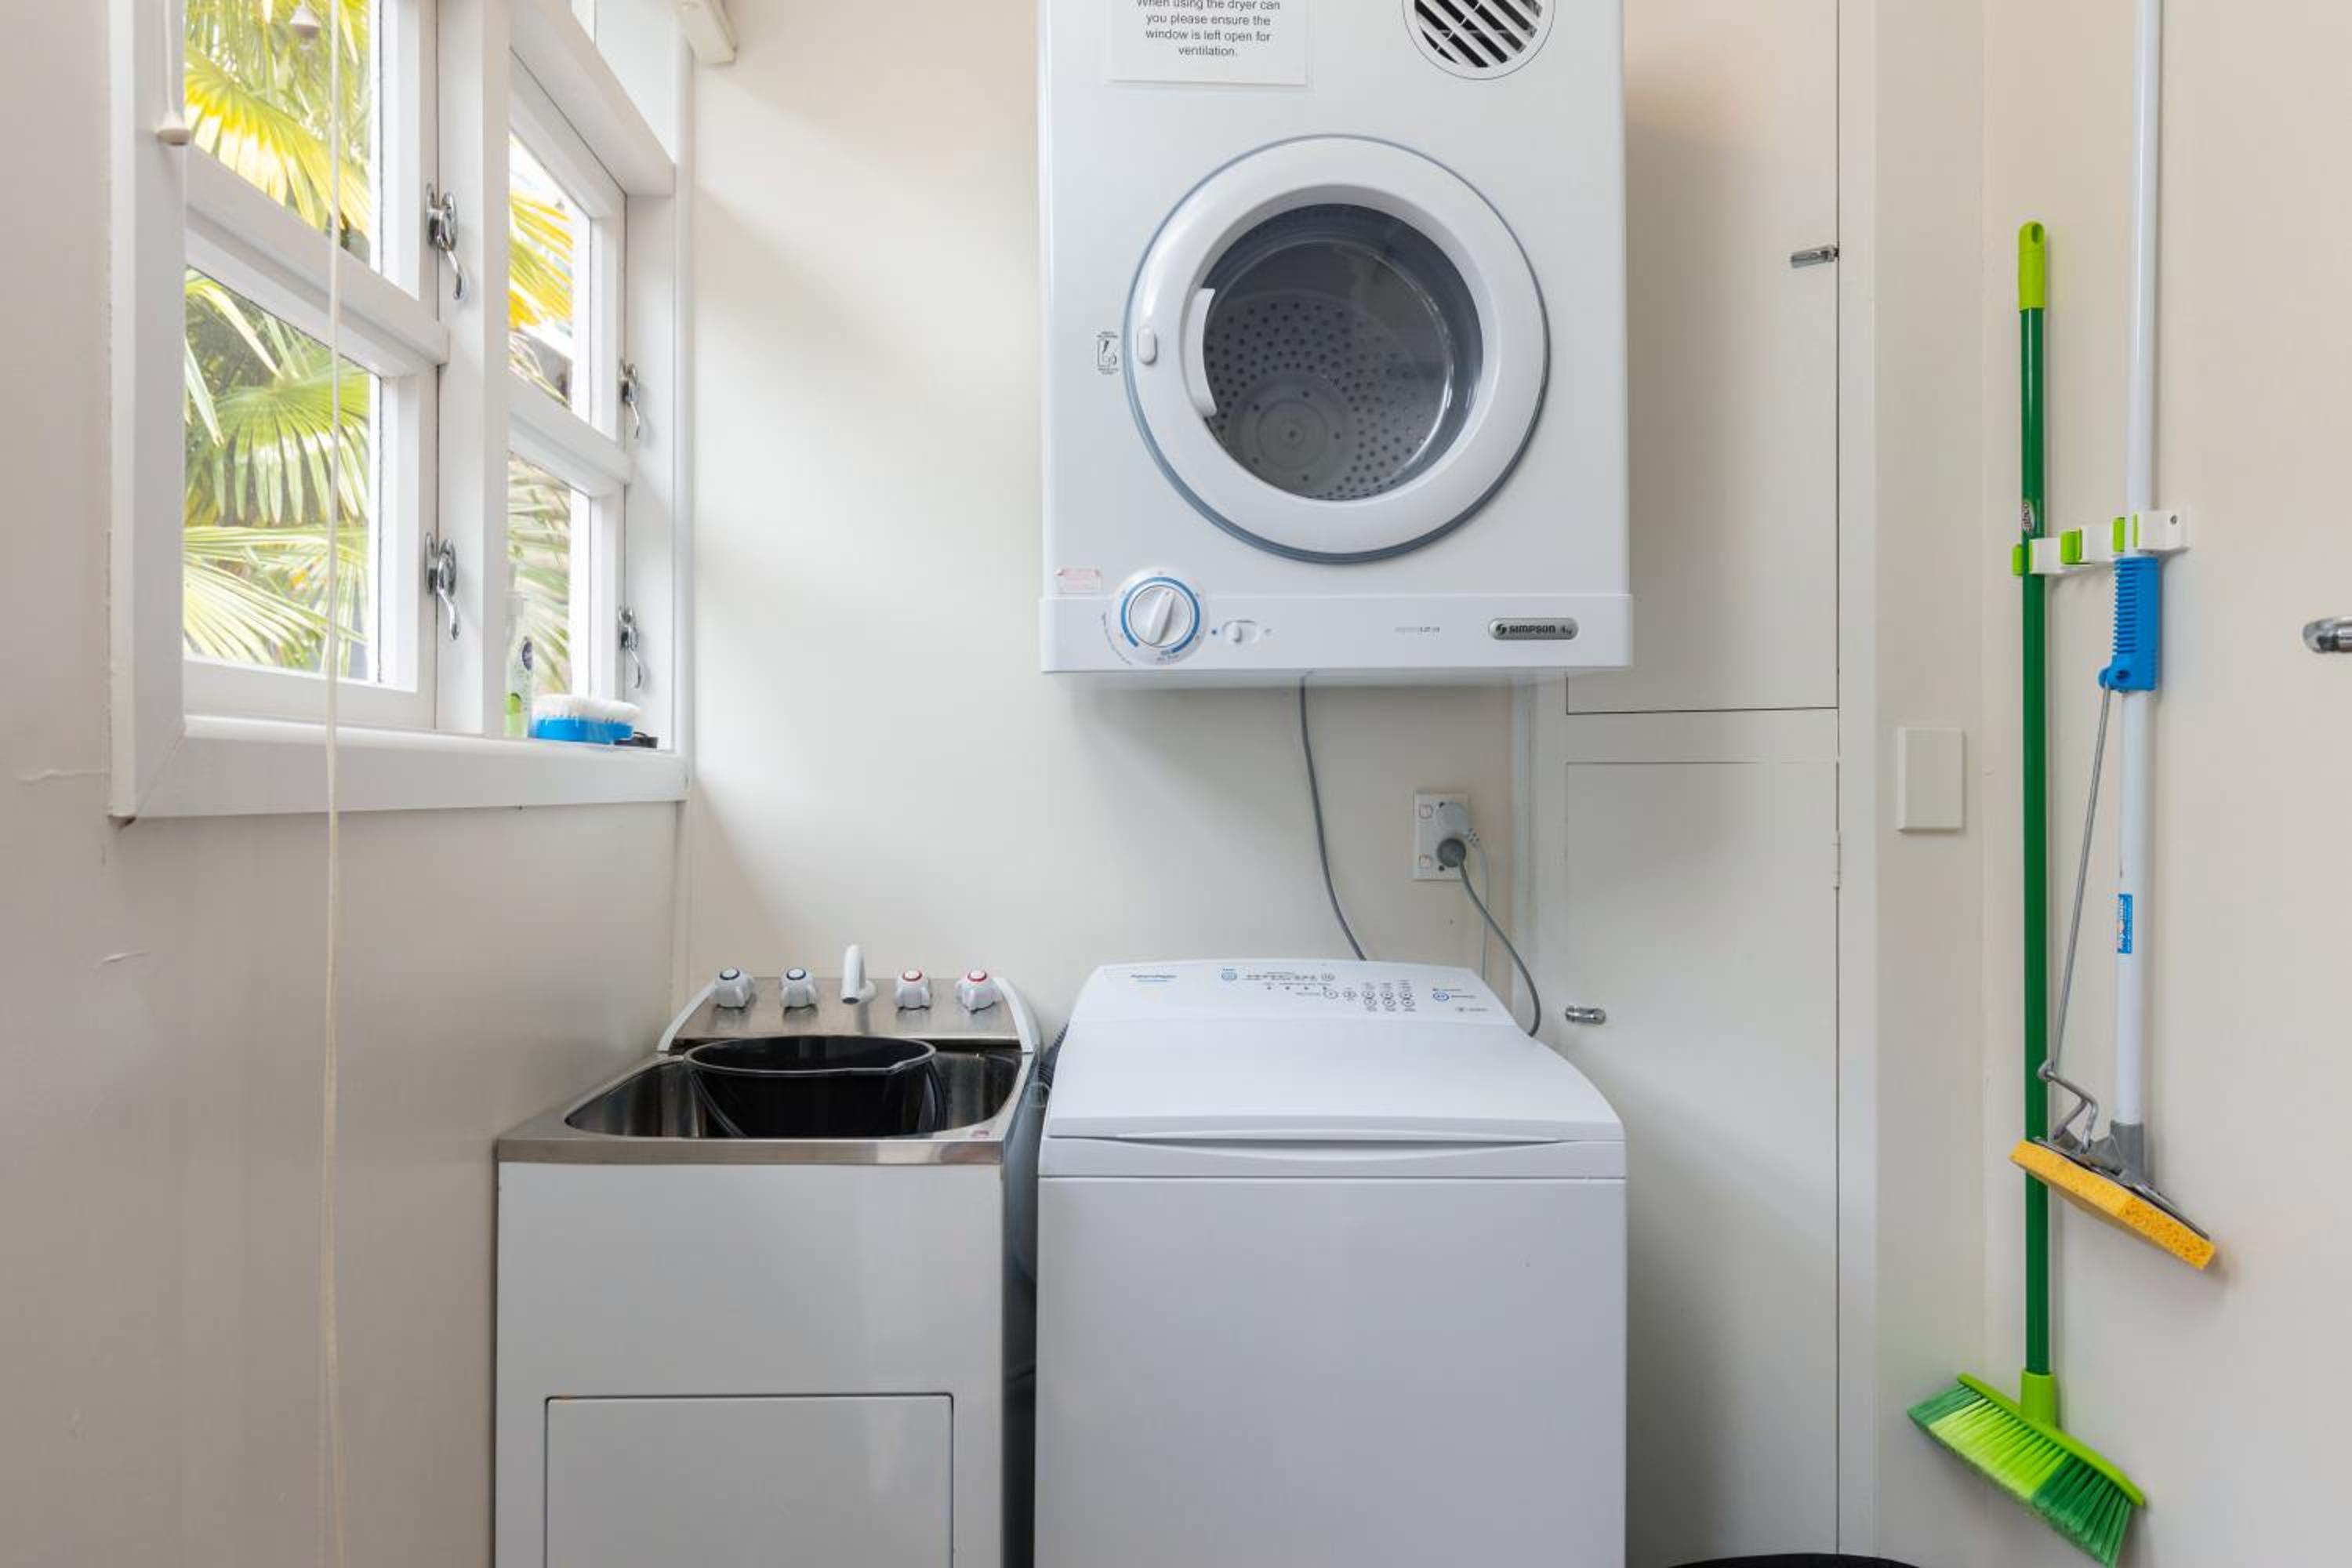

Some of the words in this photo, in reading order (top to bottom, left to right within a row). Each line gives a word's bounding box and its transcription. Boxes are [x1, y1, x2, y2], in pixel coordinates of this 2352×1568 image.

[1174, 0, 1203, 10] using
[1207, 0, 1224, 9] the
[1227, 0, 1256, 11] dryer
[1260, 1, 1279, 10] can
[1145, 14, 1167, 26] you
[1171, 13, 1207, 26] please
[1211, 16, 1249, 26] ensure
[1253, 16, 1271, 26] the
[1145, 28, 1189, 40] window
[1191, 30, 1200, 40] is
[1203, 30, 1221, 41] left
[1224, 32, 1252, 42] open
[1256, 31, 1271, 42] for
[1178, 45, 1238, 57] ventilation.
